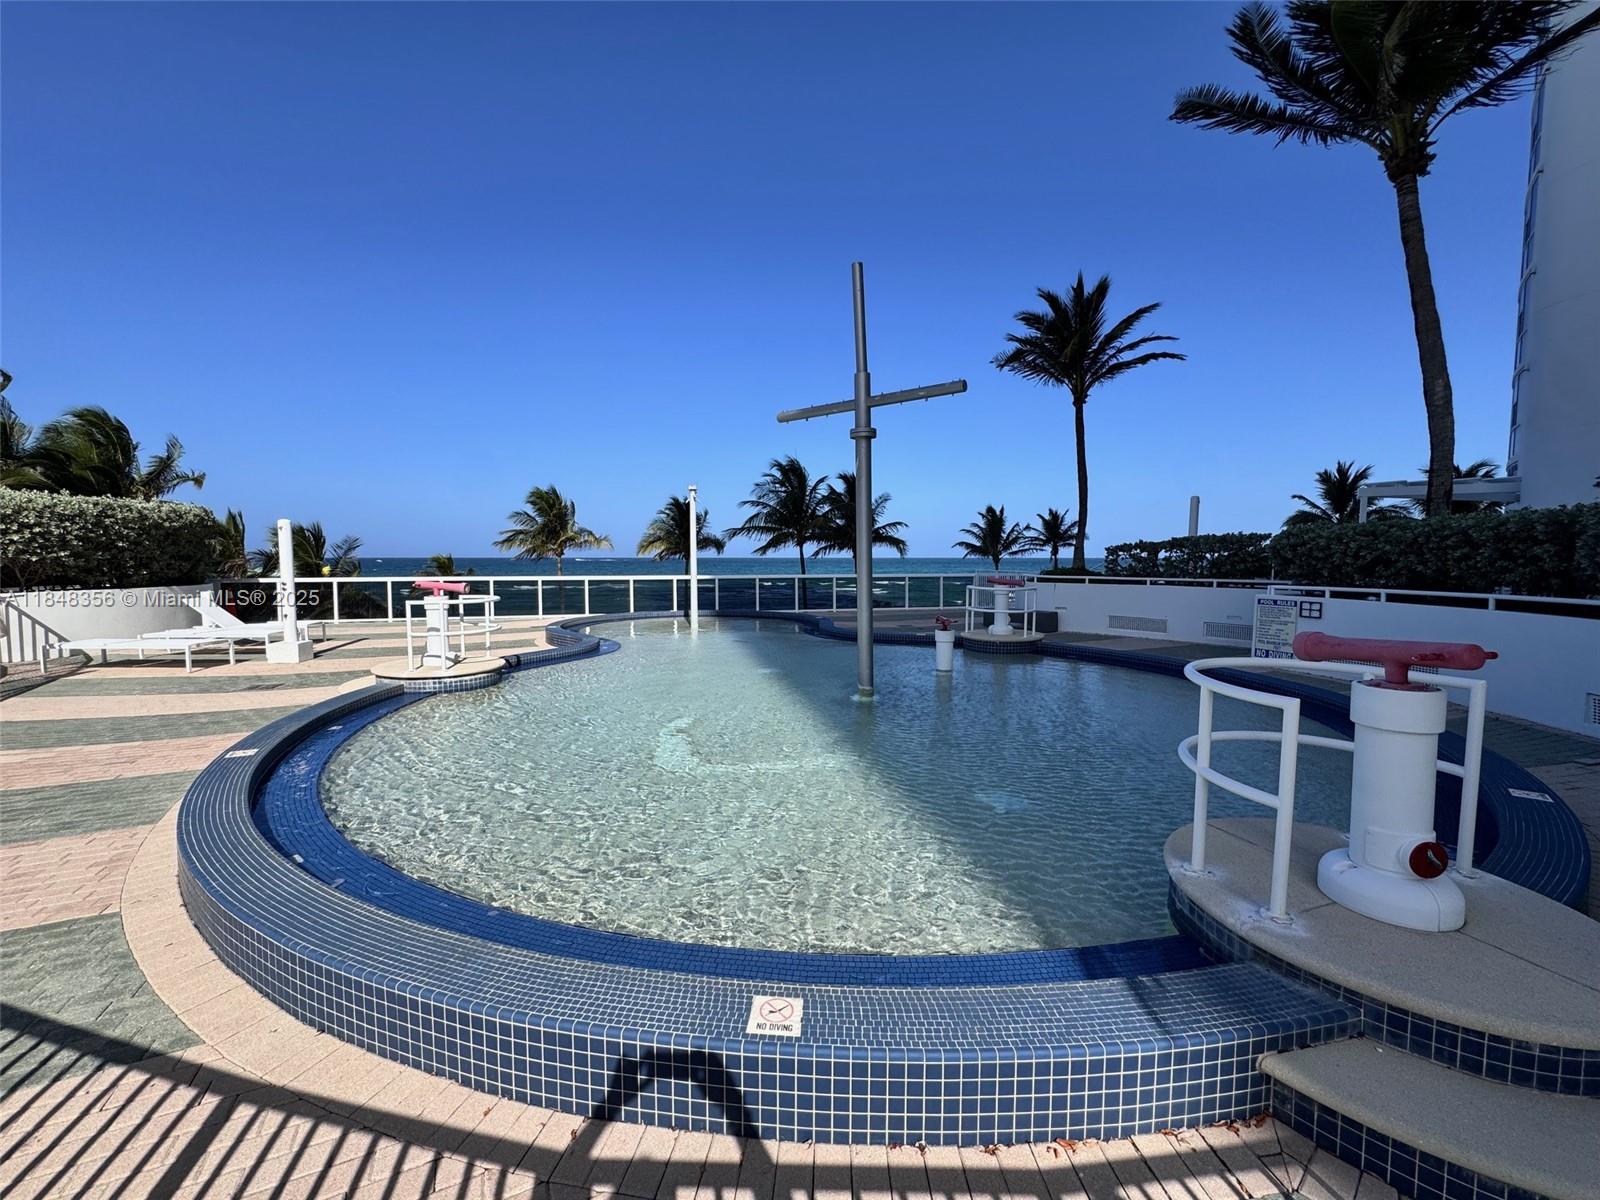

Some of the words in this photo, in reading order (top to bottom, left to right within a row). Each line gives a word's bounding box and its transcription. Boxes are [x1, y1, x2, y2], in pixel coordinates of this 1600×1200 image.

[1255, 649, 1266, 657] NO
[1268, 650, 1292, 659] DIVING
[756, 1022, 767, 1030] NO
[769, 1023, 793, 1032] DIVING
